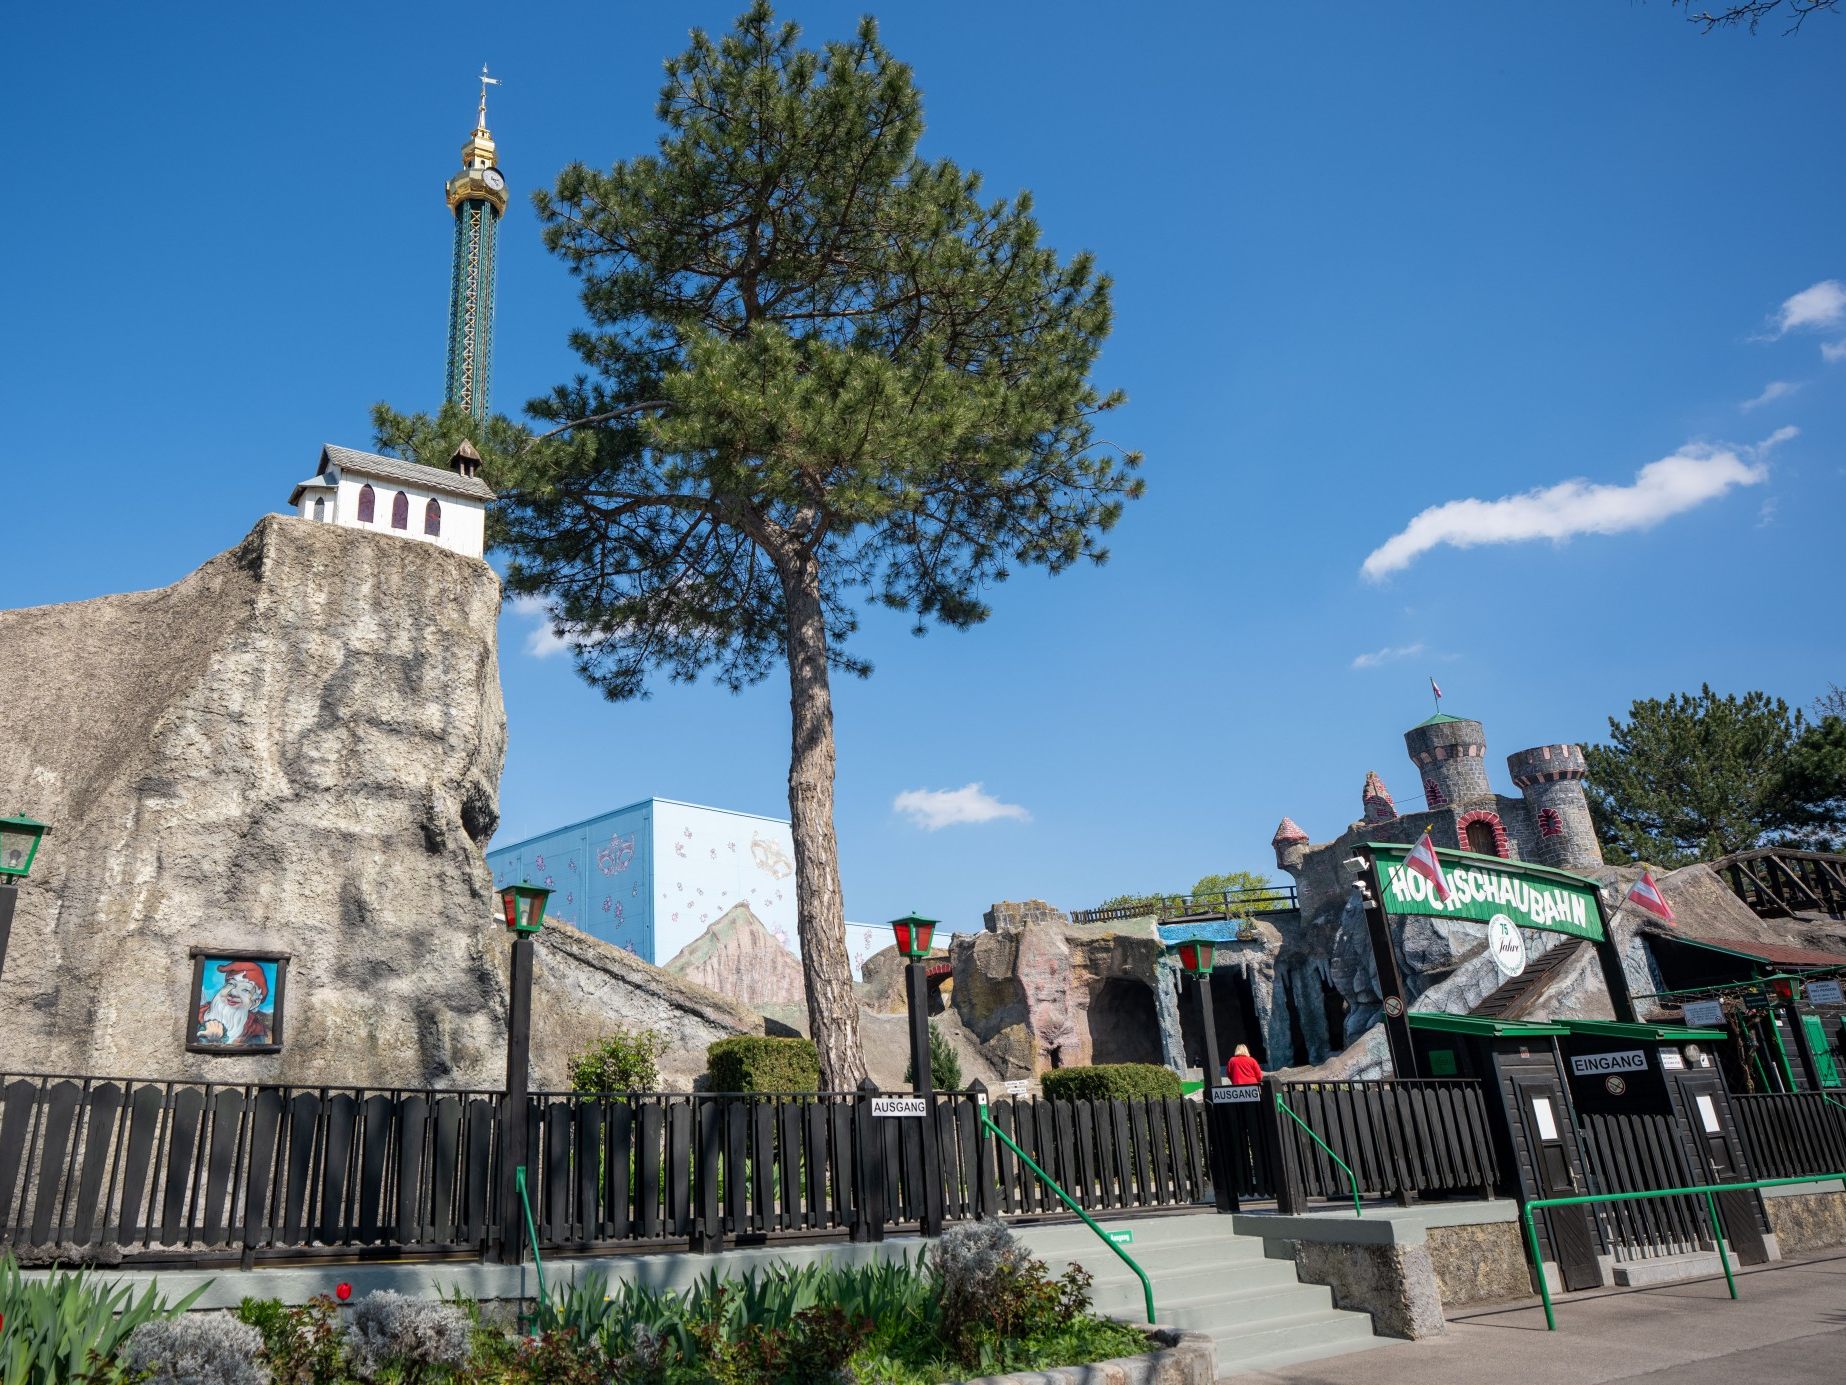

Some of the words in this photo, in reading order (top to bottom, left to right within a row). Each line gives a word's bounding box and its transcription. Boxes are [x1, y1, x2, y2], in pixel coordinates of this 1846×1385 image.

[1388, 865, 1587, 928] HOCHSCHAUBAHN
[1500, 923, 1509, 936] 75
[1499, 937, 1520, 954] Jahre
[1574, 1054, 1644, 1072] EINGANG
[1213, 1088, 1259, 1100] AUSGANG
[873, 1101, 925, 1113] AUSGANG
